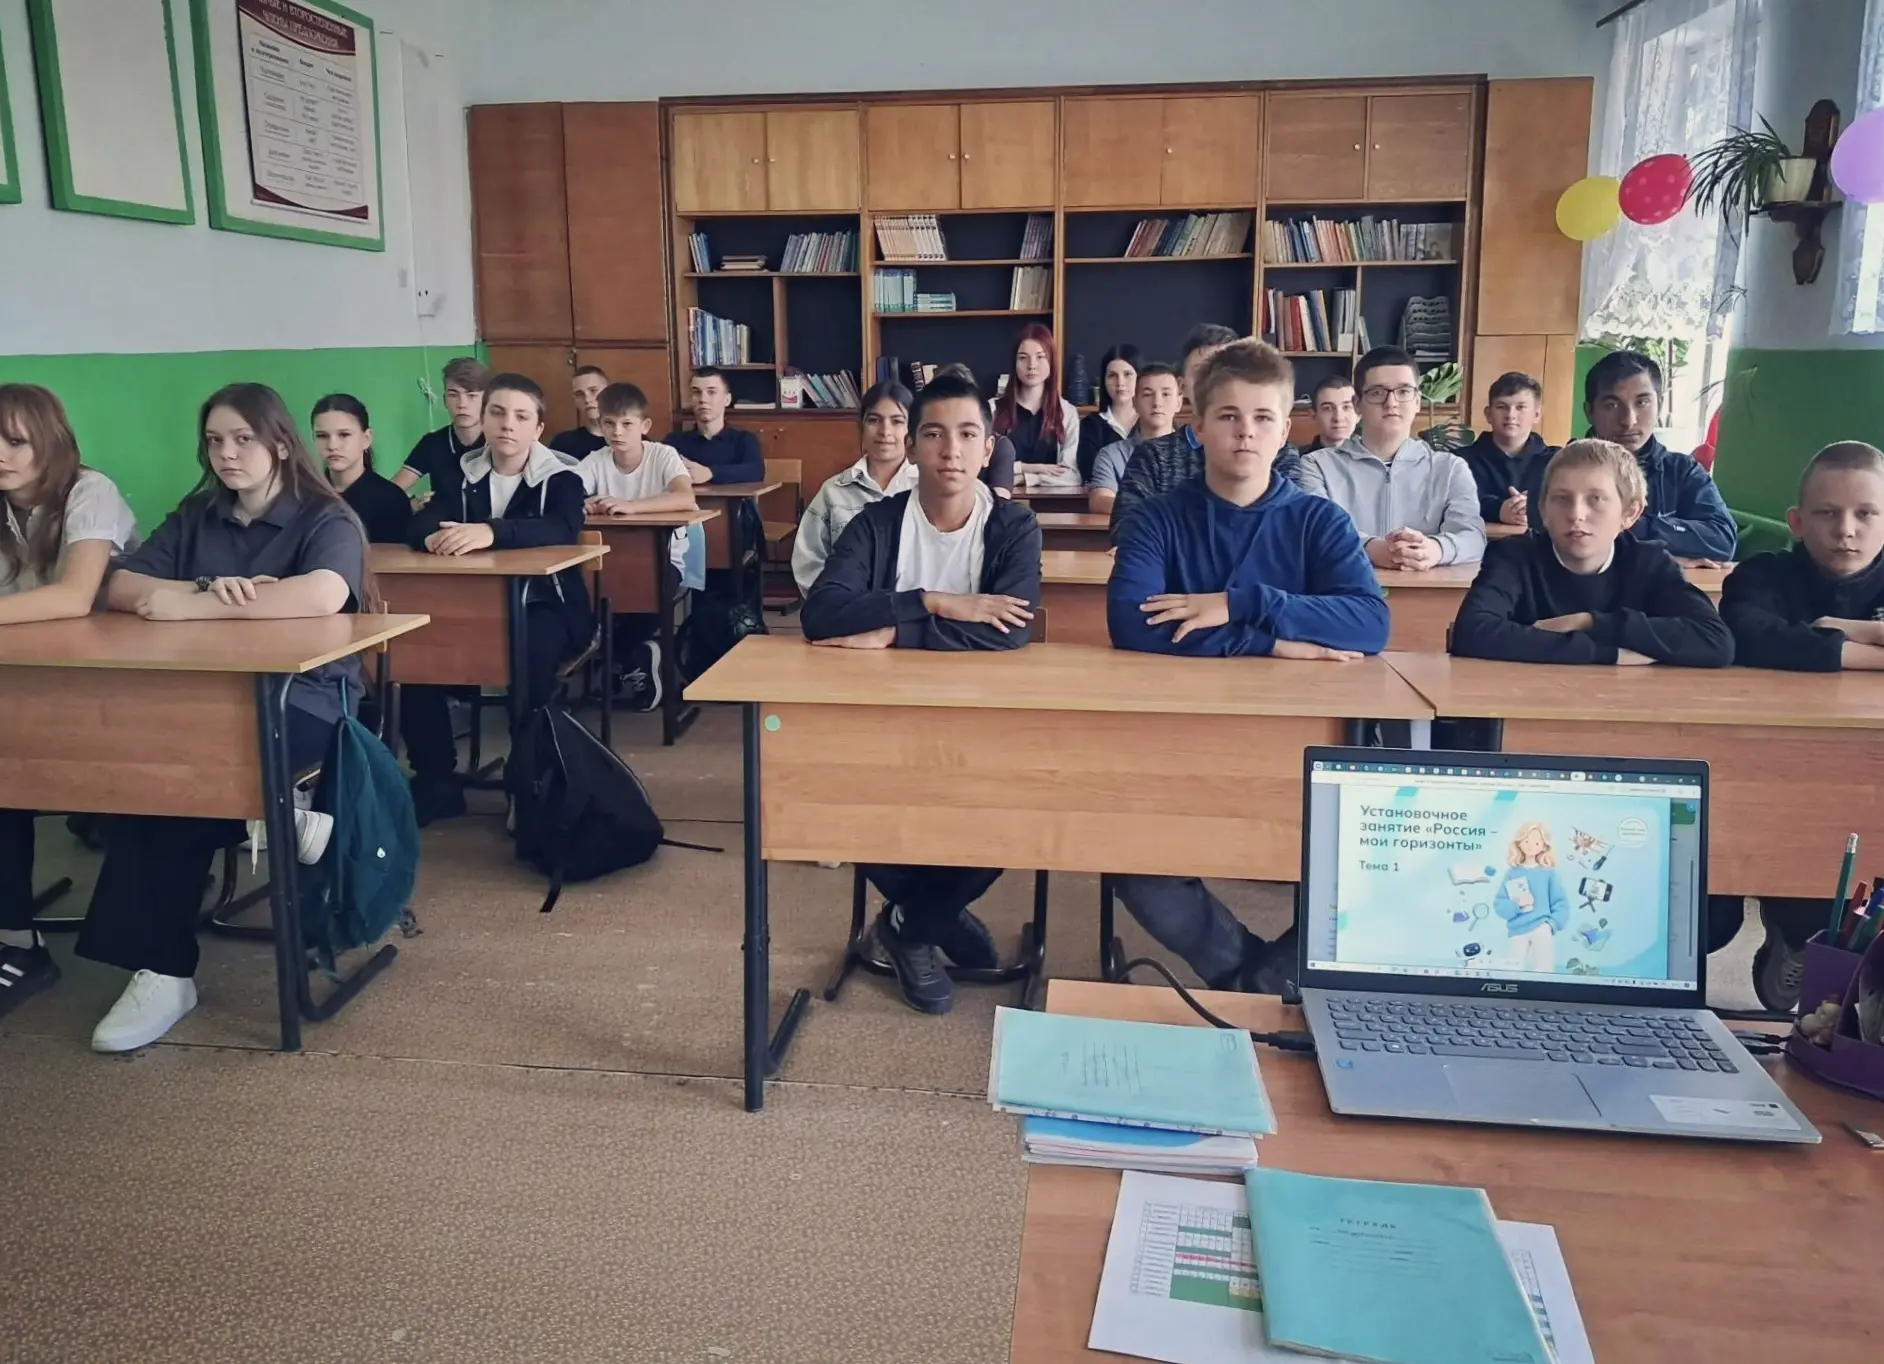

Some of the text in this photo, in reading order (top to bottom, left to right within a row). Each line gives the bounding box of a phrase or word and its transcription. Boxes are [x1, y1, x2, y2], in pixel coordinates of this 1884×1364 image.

[1360, 805, 1468, 821] Установочное
[1359, 822, 1421, 834] занятие
[1425, 823, 1486, 837] «Россия
[1359, 837, 1482, 851] мои горизонты»
[1359, 860, 1400, 872] Тема 1
[1481, 983, 1518, 993] ASUS
